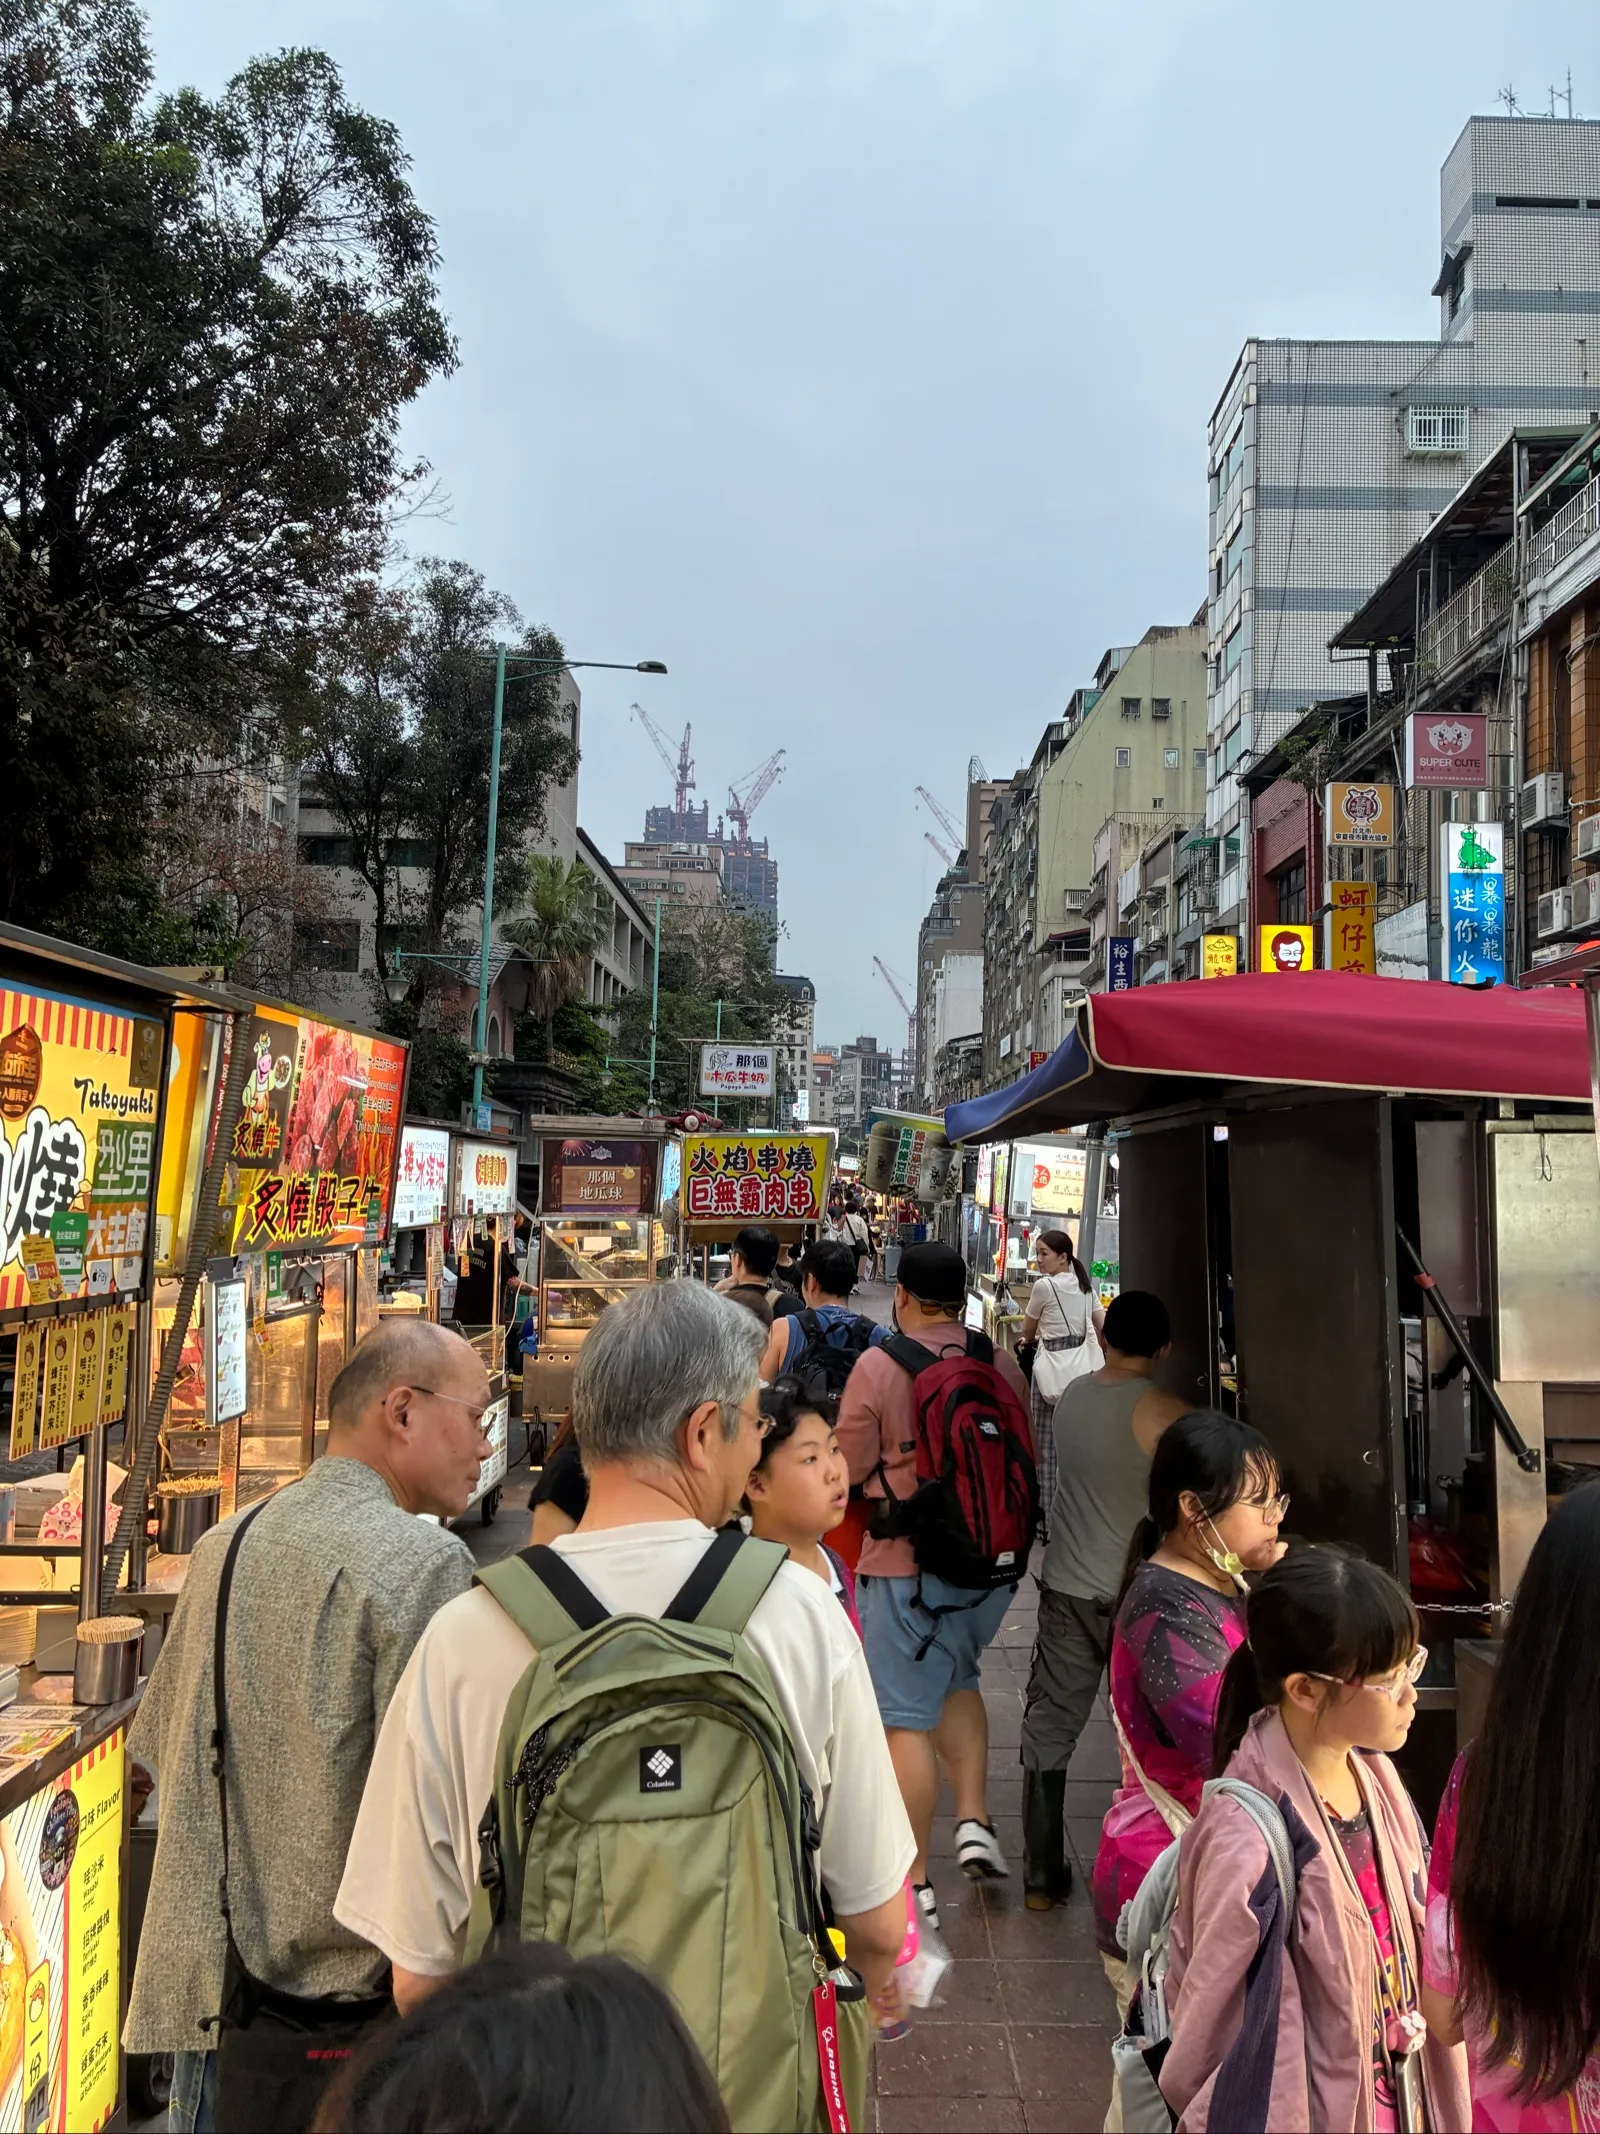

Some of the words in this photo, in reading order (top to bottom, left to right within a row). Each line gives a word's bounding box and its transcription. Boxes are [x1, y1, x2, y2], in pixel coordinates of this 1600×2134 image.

[1420, 757, 1452, 767] SUPER
[1454, 758, 1481, 768] CUTE
[710, 1069, 765, 1084] 木瓜牛奶
[736, 1054, 768, 1069] 那個
[74, 1076, 154, 1117] Takoyaki
[92, 1128, 153, 1196] 型男
[588, 1170, 616, 1184] 那個
[691, 1143, 816, 1173] 火焰串燒
[247, 1172, 382, 1241] 炙燒骰子牛
[580, 1186, 623, 1200] 地瓜球
[689, 1174, 814, 1215] 巨無霸肉串
[98, 1269, 109, 1285] Pay
[646, 1779, 675, 1788] Columbia
[80, 1808, 96, 1833] 口味
[96, 1788, 121, 1820] Flavor
[83, 1854, 105, 1885] 哇沙米
[83, 1877, 99, 1900] Wasabi
[82, 1909, 110, 1949] 招牌醬燒
[82, 1969, 109, 2012] 香香辣辣
[29, 2030, 43, 2087] 一份
[80, 2064, 96, 2088] Honey
[95, 2043, 112, 2071] Mustard
[81, 2030, 109, 2075] 蜂蜜芥末
[828, 2047, 842, 2110] BOEING
